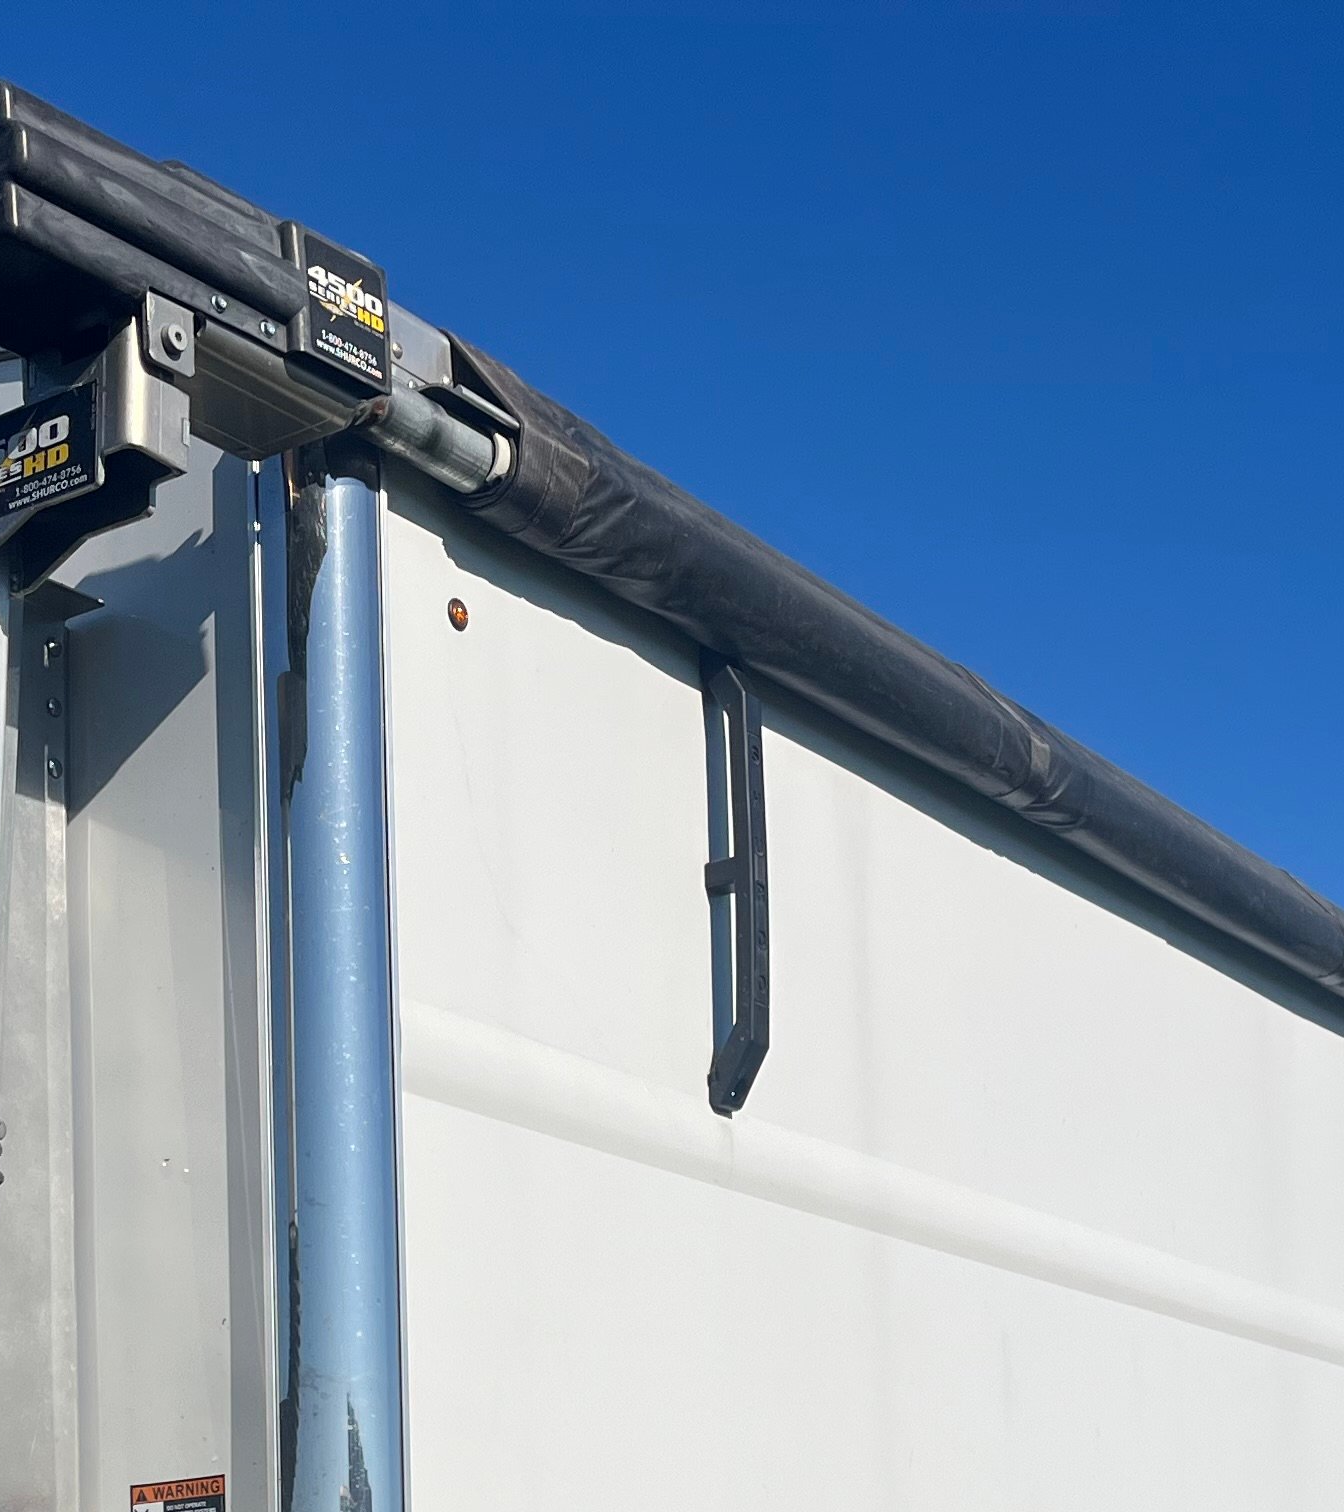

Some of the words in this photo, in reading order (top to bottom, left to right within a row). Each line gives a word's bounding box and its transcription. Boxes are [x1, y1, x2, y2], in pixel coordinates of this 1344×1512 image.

[307, 265, 384, 317] 4500
[357, 306, 385, 334] HD
[316, 338, 383, 380] www.SHURCO.com
[23, 443, 70, 478] HD
[8, 474, 88, 510] www.SHURCO.com
[15, 464, 82, 498] 1-800-474-8756
[152, 1480, 220, 1500] WARNING
